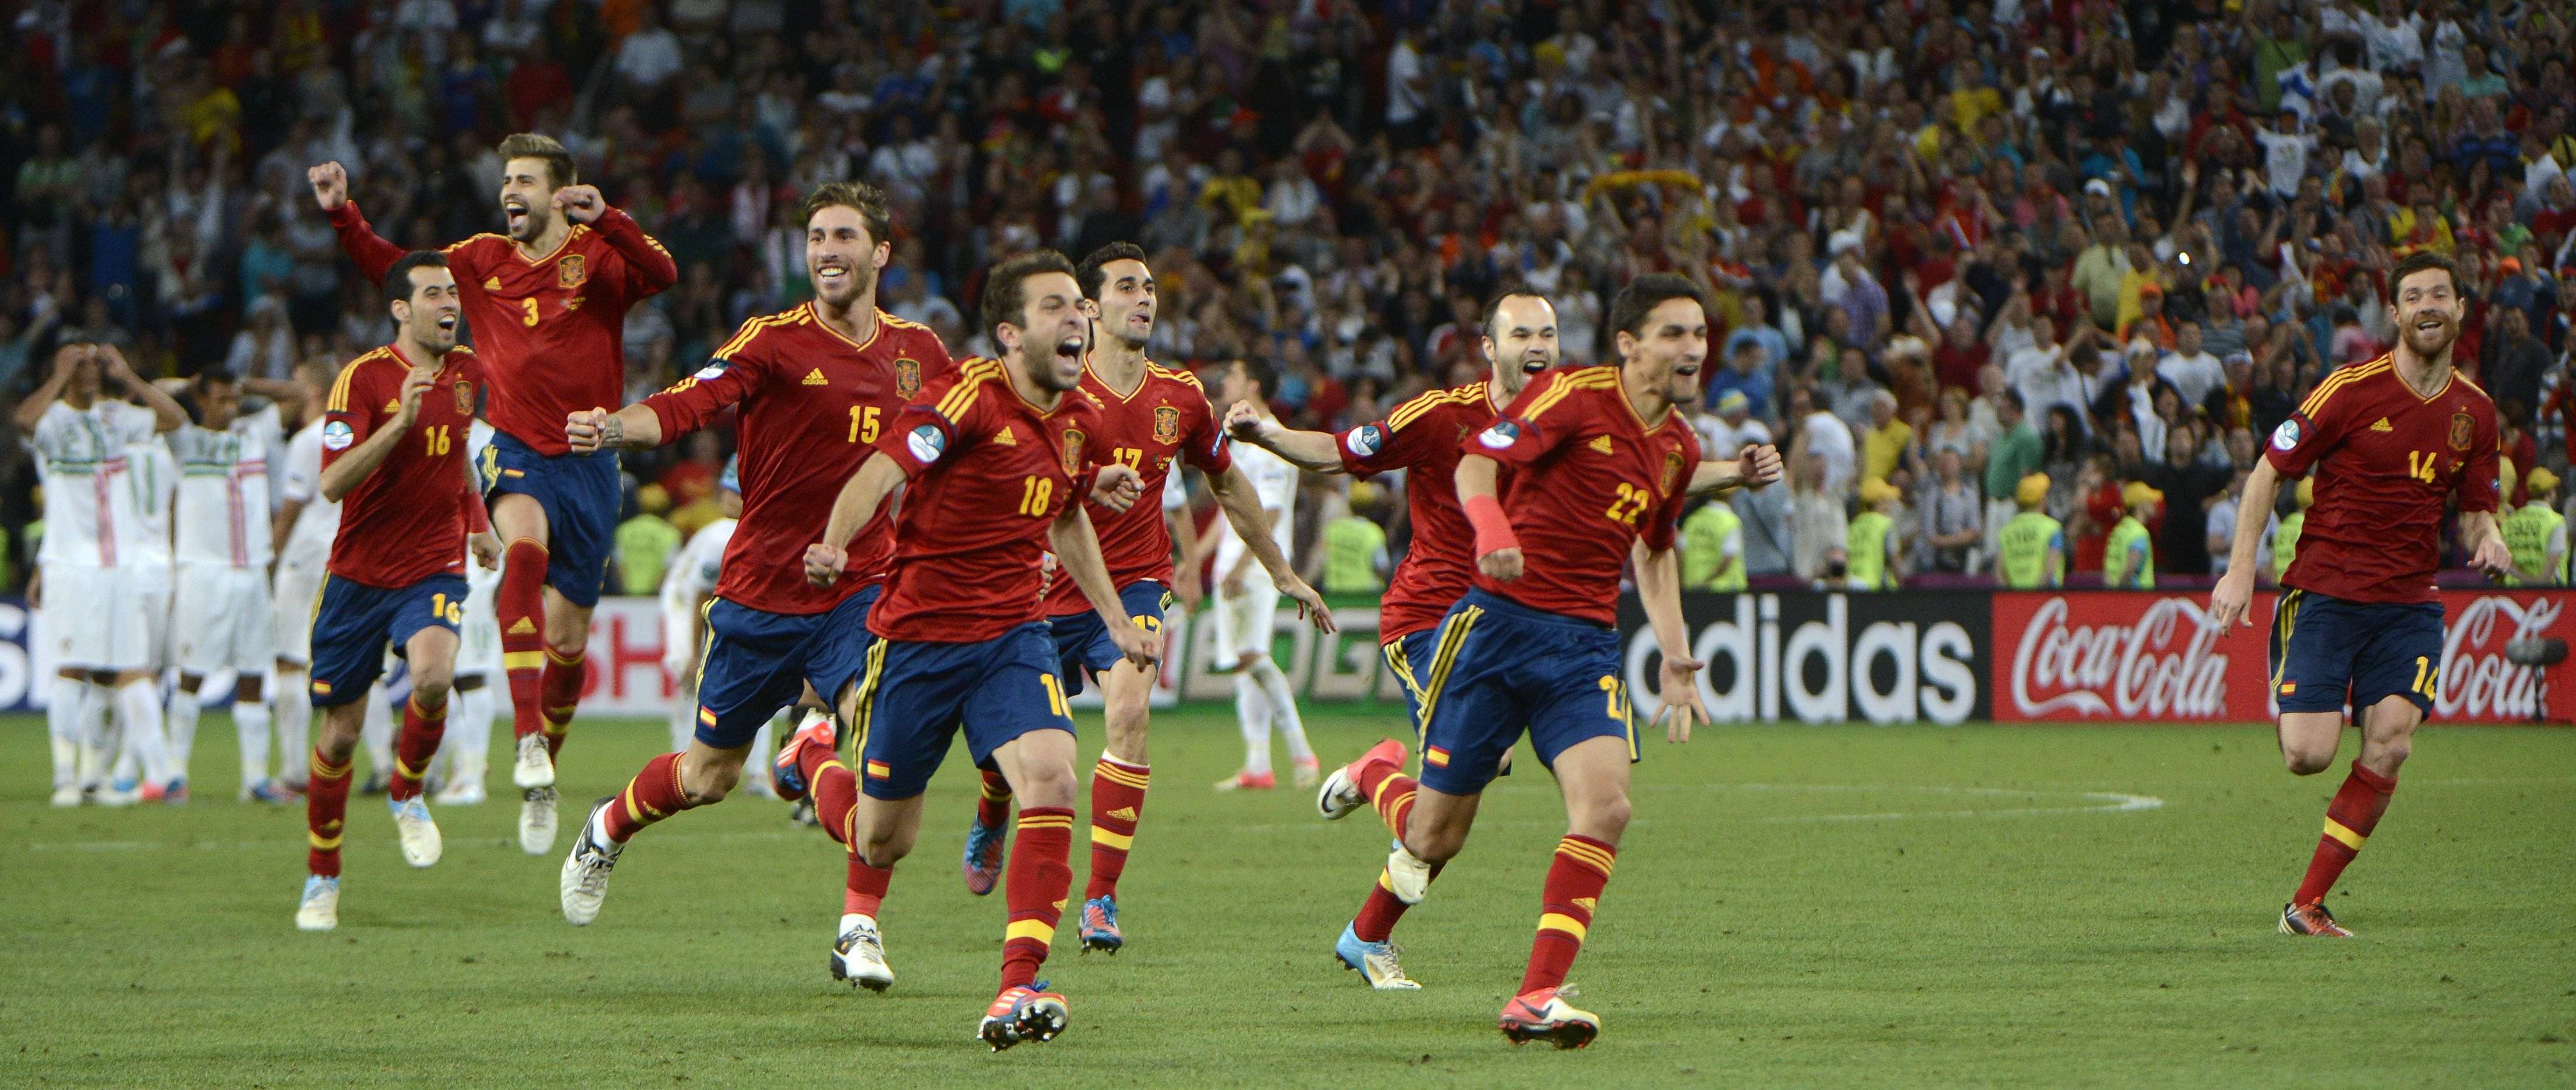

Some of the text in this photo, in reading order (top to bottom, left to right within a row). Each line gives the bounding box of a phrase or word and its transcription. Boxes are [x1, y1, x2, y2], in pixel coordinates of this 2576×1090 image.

[523, 297, 539, 327] 3
[425, 424, 451, 457] 16
[848, 405, 881, 444] 15
[2409, 450, 2438, 484] 14
[1019, 474, 1053, 518] 18
[1605, 482, 1650, 524] 22
[1626, 592, 1978, 724] adidas
[2011, 596, 2228, 718] Coca-Cola
[2412, 655, 2440, 702] 14
